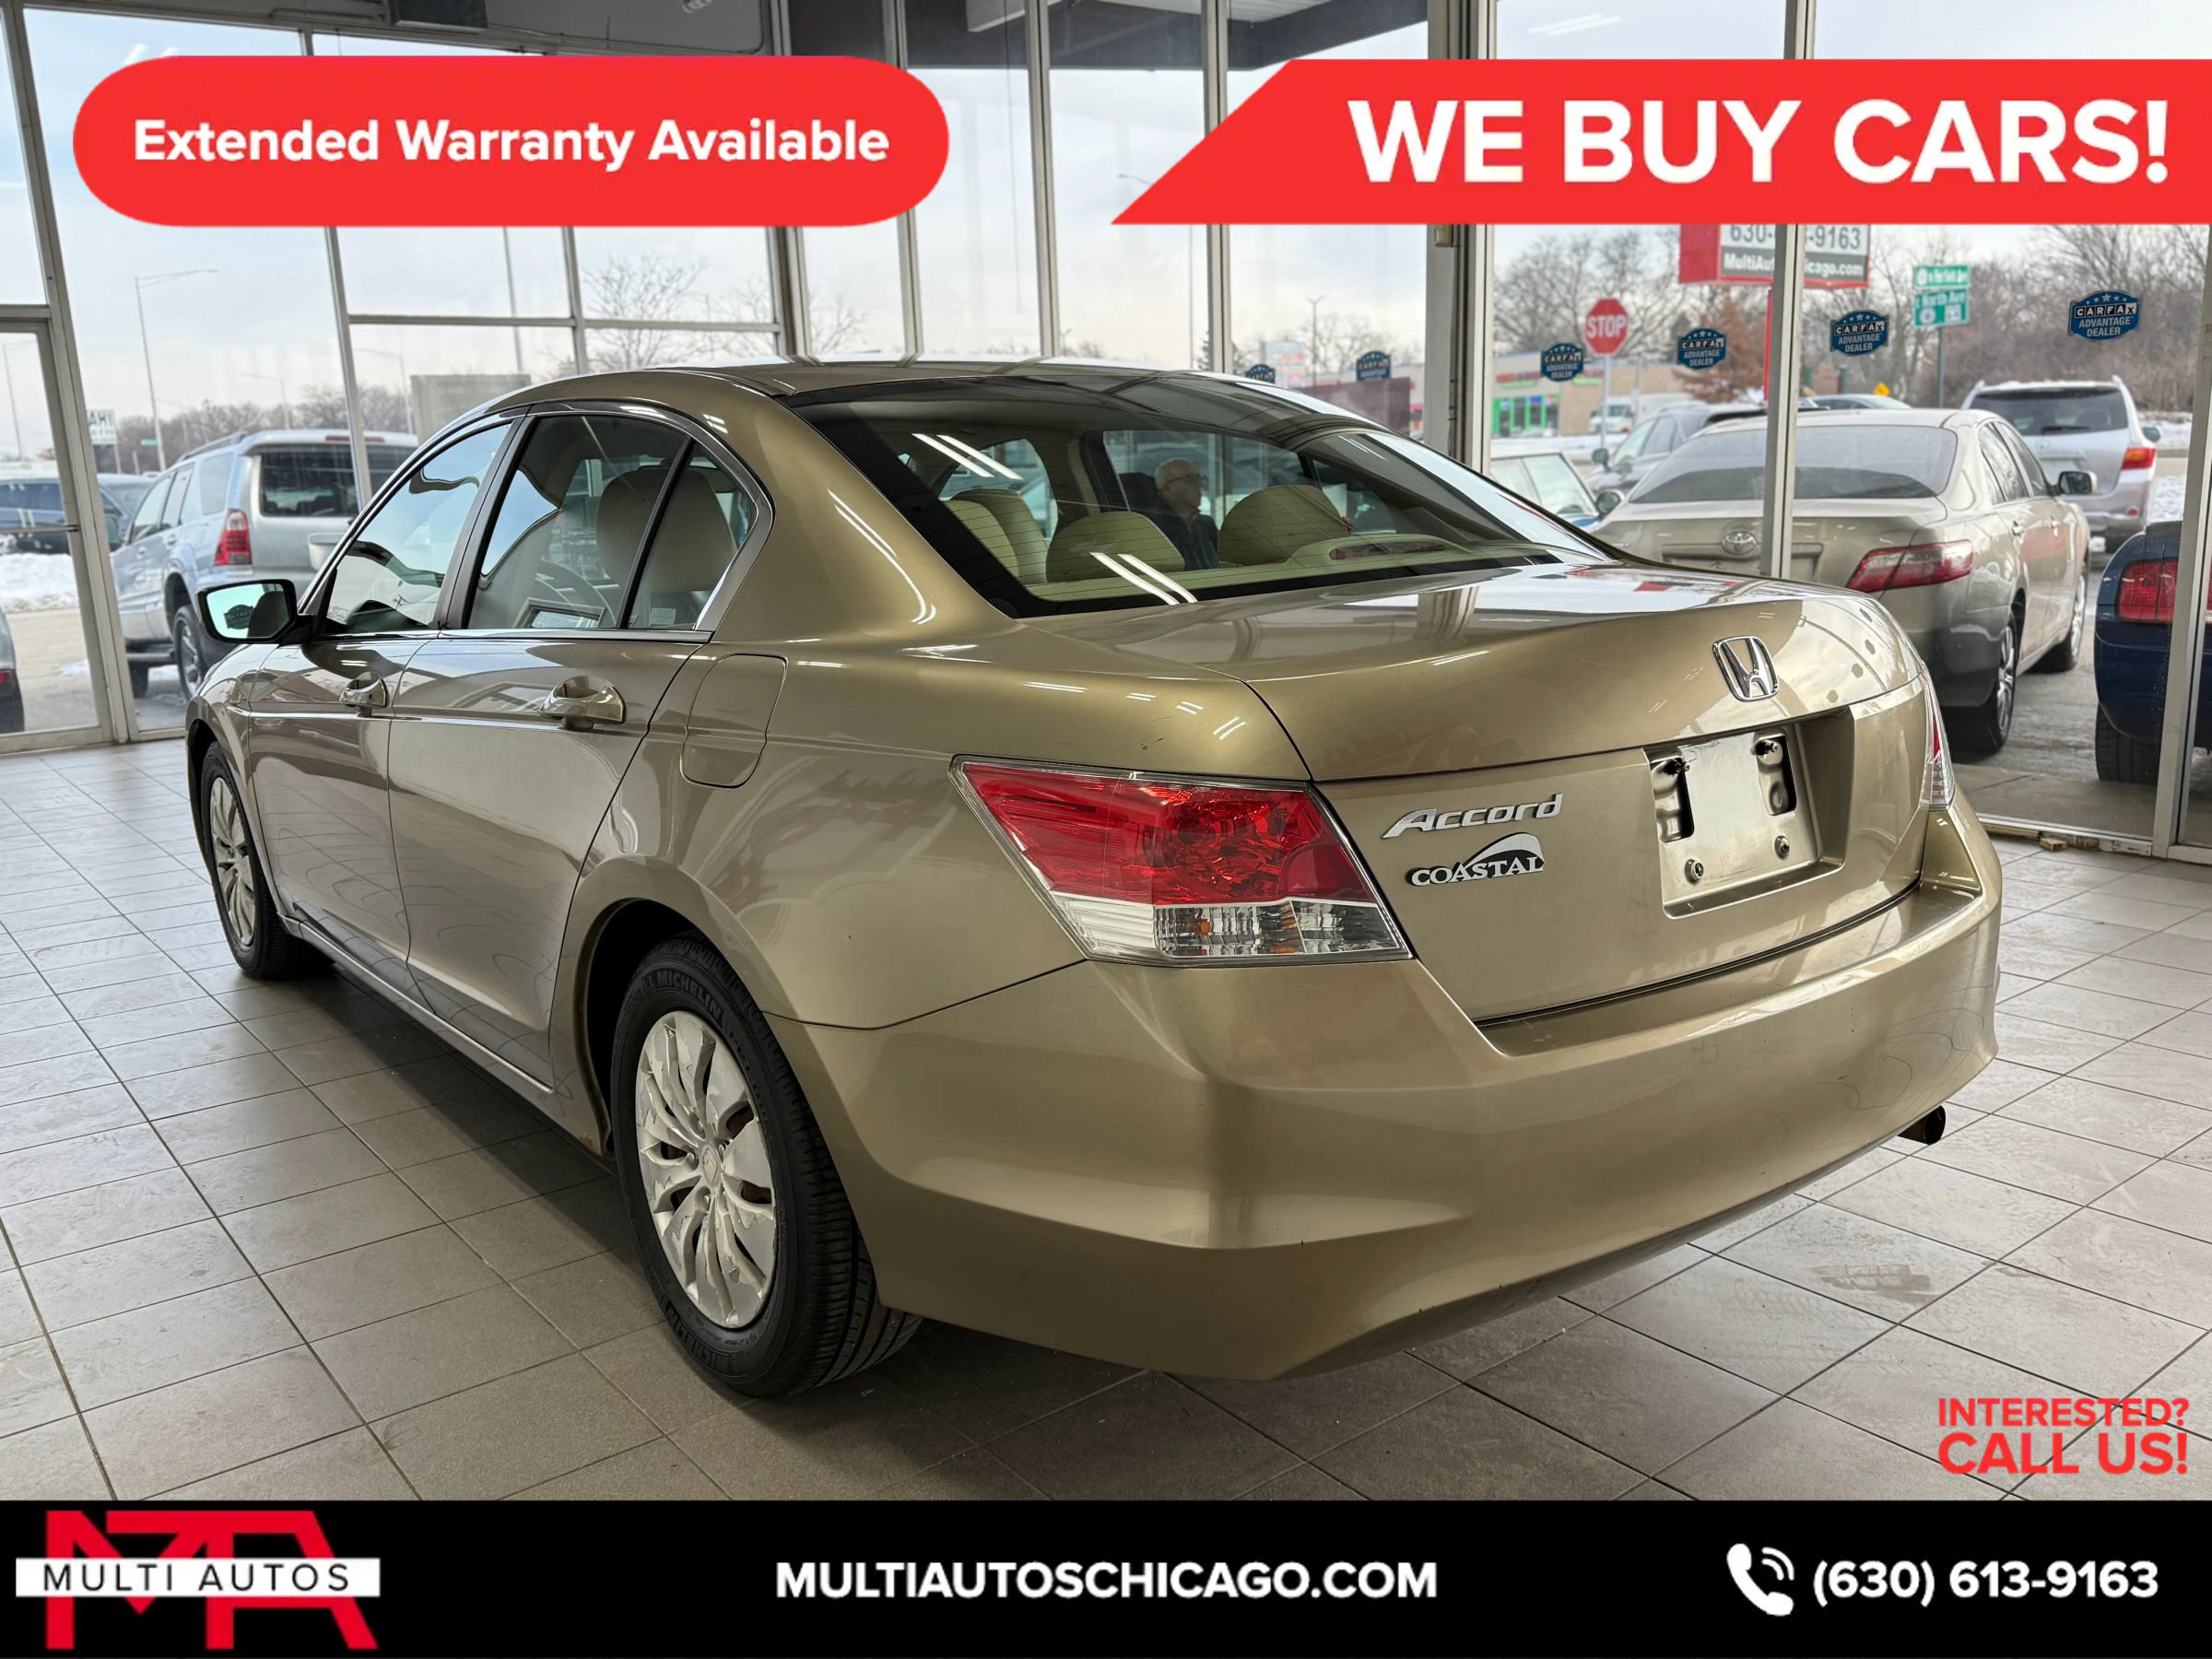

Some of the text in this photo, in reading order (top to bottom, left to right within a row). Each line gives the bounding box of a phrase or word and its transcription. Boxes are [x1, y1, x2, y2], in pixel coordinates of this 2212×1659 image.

[2076, 304, 2136, 317] CARFAX
[1587, 315, 1626, 339] STOP
[2079, 316, 2131, 329] ADVANTAGE
[1836, 323, 1884, 335] CARFAX
[2087, 327, 2122, 337] DEALER
[1681, 338, 1724, 349] CARFAX
[1839, 333, 1880, 345] ADVANTAGE
[1845, 342, 1873, 353] DEALER
[1544, 353, 1581, 363] CARFAX
[1684, 349, 1720, 359] ADVANTAGE
[1689, 358, 1713, 367] DEALER
[1382, 794, 1564, 839] Accord
[1410, 856, 1545, 887] COASTAL
[655, 970, 723, 1019] MICHELIN
